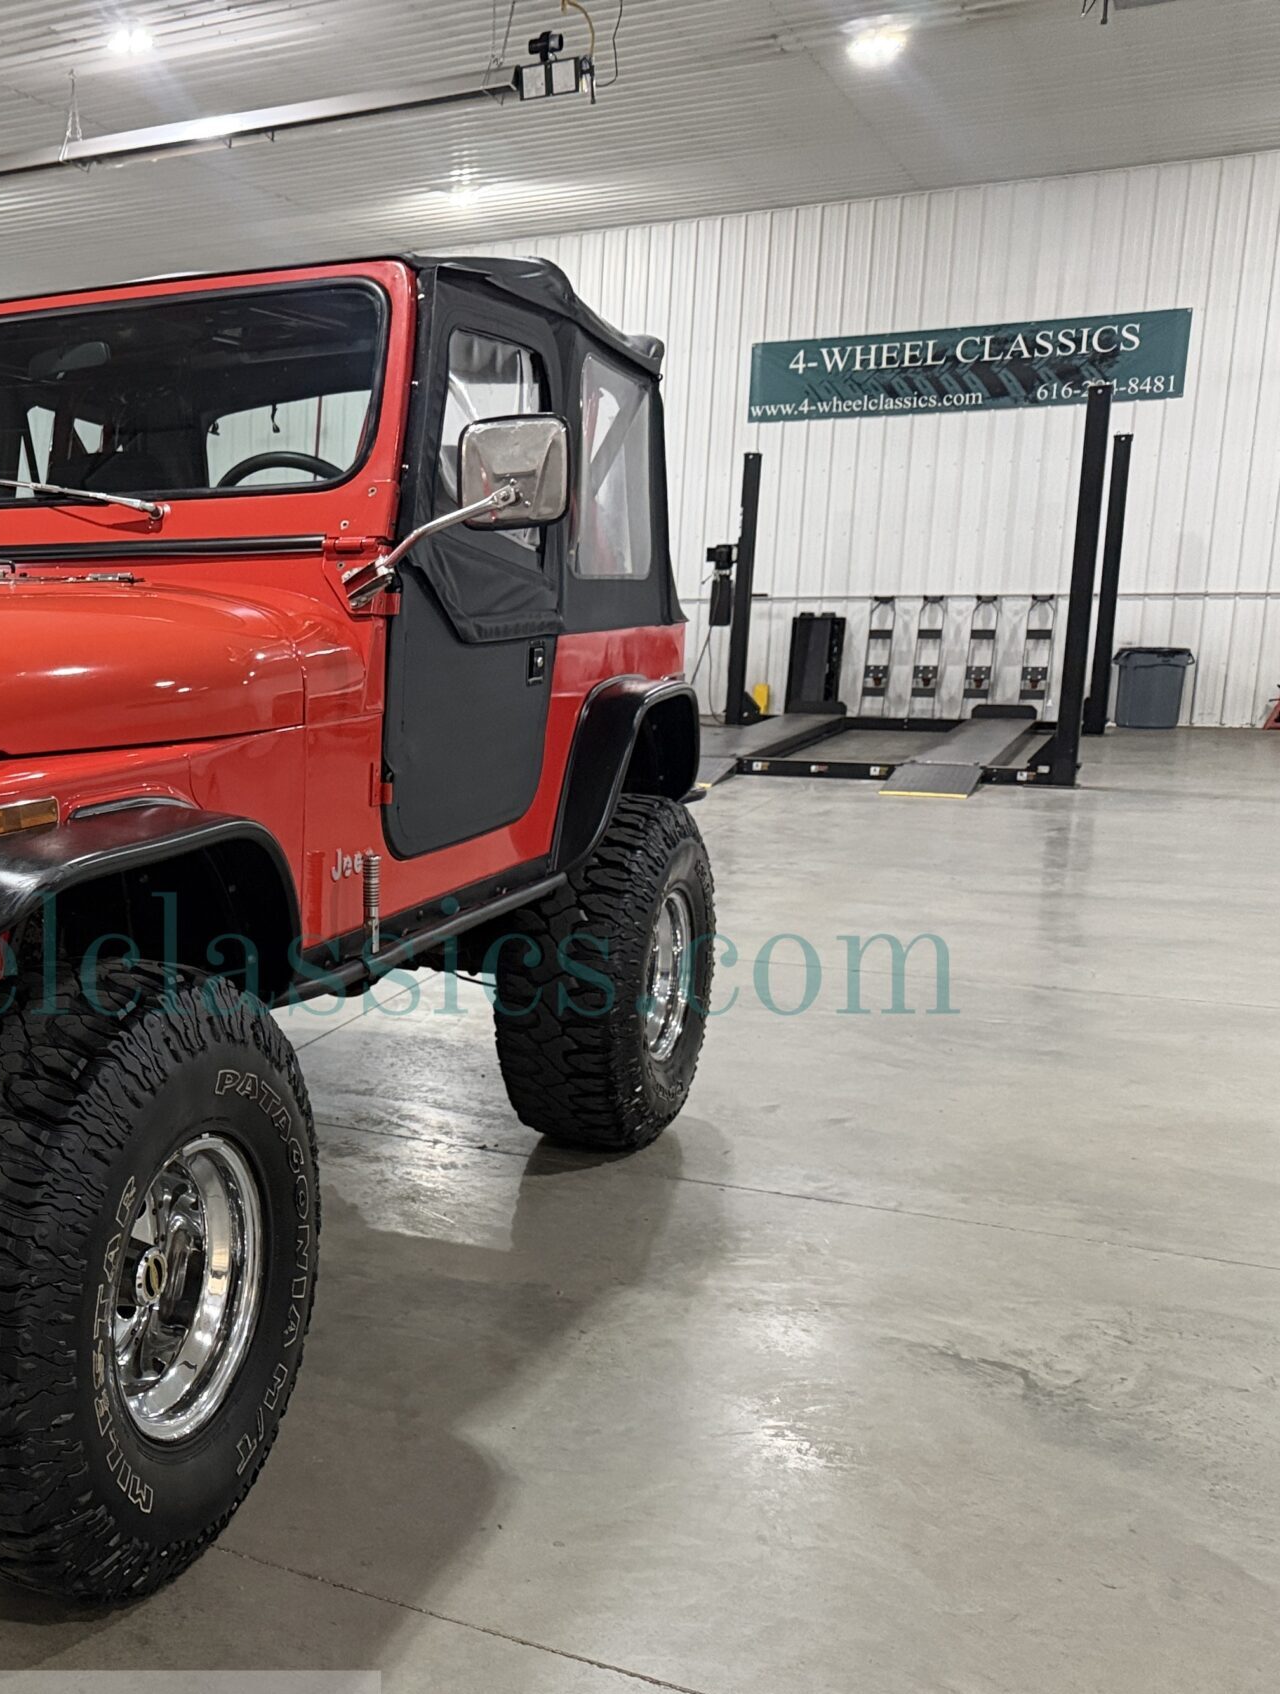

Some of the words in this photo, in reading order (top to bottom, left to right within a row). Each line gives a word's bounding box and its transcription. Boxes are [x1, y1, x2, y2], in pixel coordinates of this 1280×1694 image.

[789, 340, 947, 374] 4-WHEEL
[955, 323, 1141, 365] CLASSICS
[750, 390, 983, 419] www.4-wheelclassics.com
[215, 1069, 310, 1348] PATAGONIA
[236, 1364, 288, 1477] M/T
